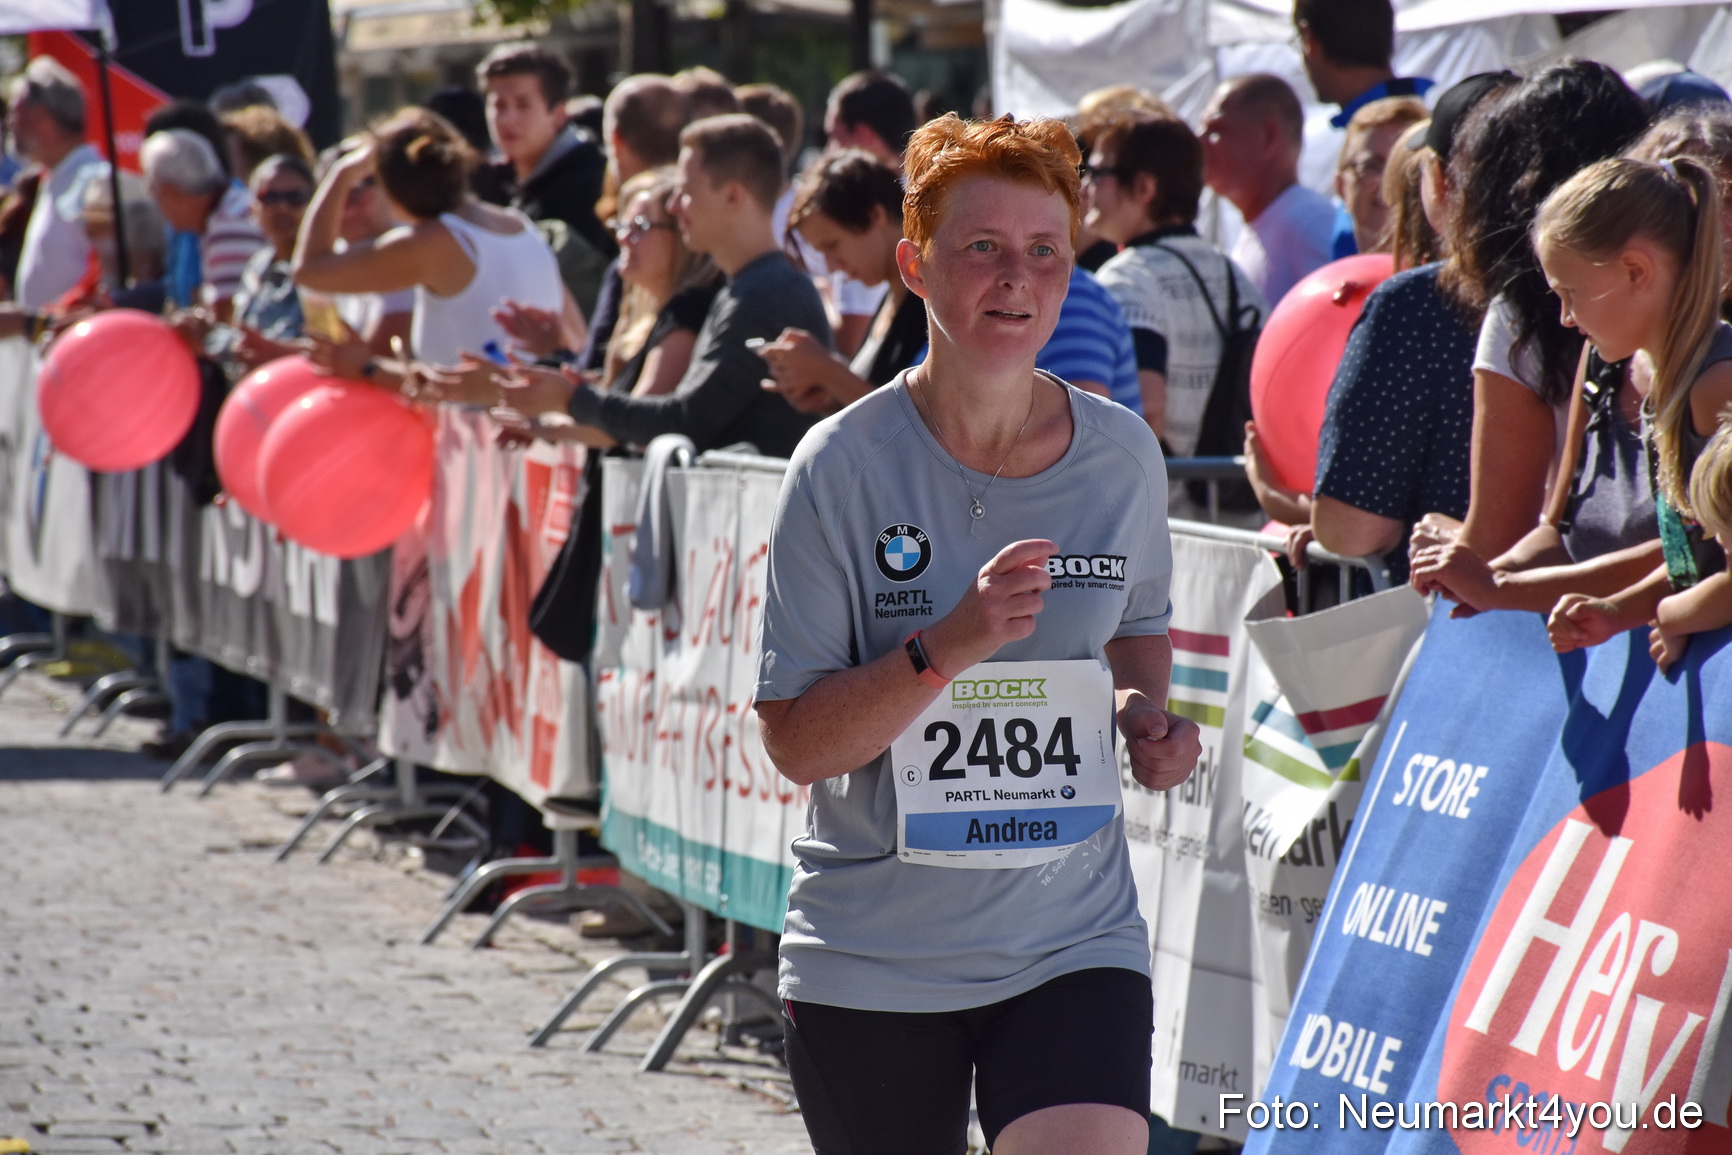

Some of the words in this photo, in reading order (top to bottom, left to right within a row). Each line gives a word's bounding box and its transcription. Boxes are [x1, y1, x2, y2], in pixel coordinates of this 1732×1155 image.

[879, 525, 927, 544] BMW
[1045, 554, 1127, 581] BOCK
[1051, 580, 1073, 590] pired
[1075, 580, 1085, 590] by
[1087, 581, 1108, 589] smart
[874, 589, 933, 608] PARTL
[874, 605, 933, 619] Neumarkt
[951, 678, 1047, 701] BOCK
[951, 701, 981, 710] inspired
[982, 701, 991, 709] by
[1015, 700, 1048, 709] concepts
[924, 716, 1081, 781] 2484
[945, 790, 991, 802] PARTL
[994, 788, 1056, 801] Neumarkt
[1392, 753, 1489, 819] STORE
[966, 816, 1058, 844] Andrea
[1041, 873, 1055, 888] 16.
[1341, 881, 1447, 957] ONLINE
